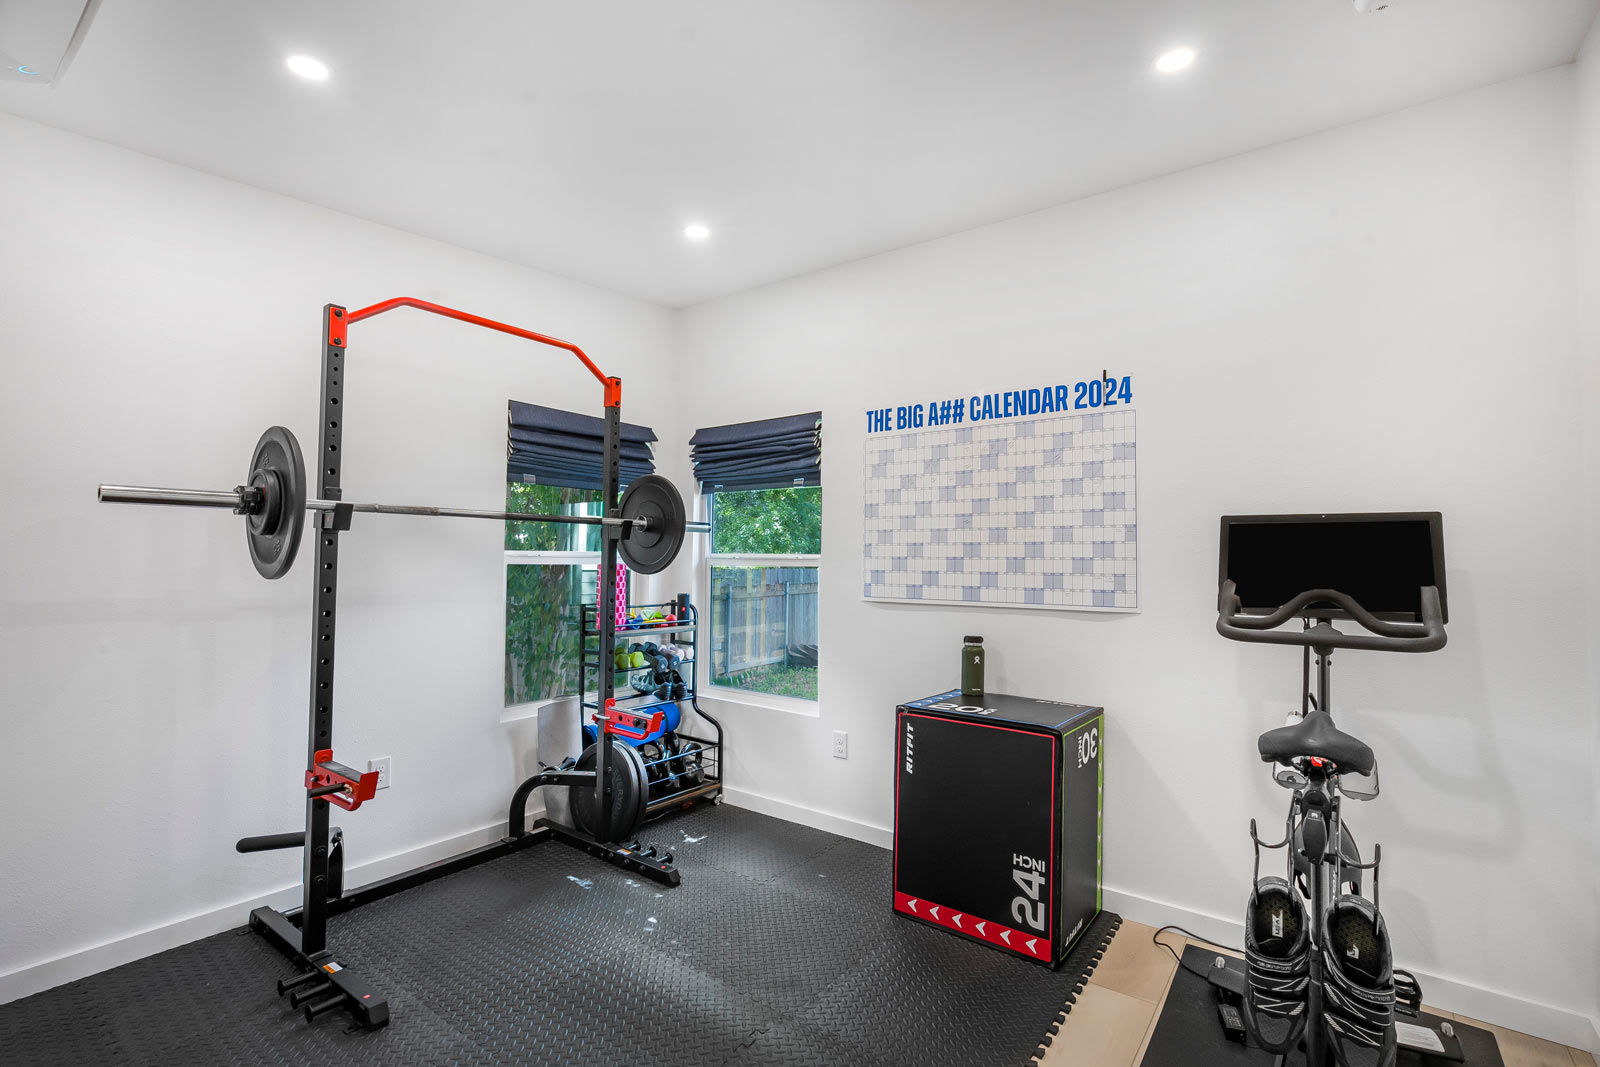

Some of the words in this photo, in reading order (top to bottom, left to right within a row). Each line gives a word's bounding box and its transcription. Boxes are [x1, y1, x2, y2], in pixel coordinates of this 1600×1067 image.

[866, 408, 893, 433] THE
[896, 404, 924, 430] BIG
[927, 398, 965, 427] A##
[969, 384, 1069, 422] CALENDAR
[1074, 376, 1133, 410] 2024
[927, 702, 984, 713] 20
[906, 722, 914, 774] RITFIT
[1082, 727, 1098, 765] 30
[1012, 853, 1046, 873] INCH
[1011, 869, 1046, 931] 24
